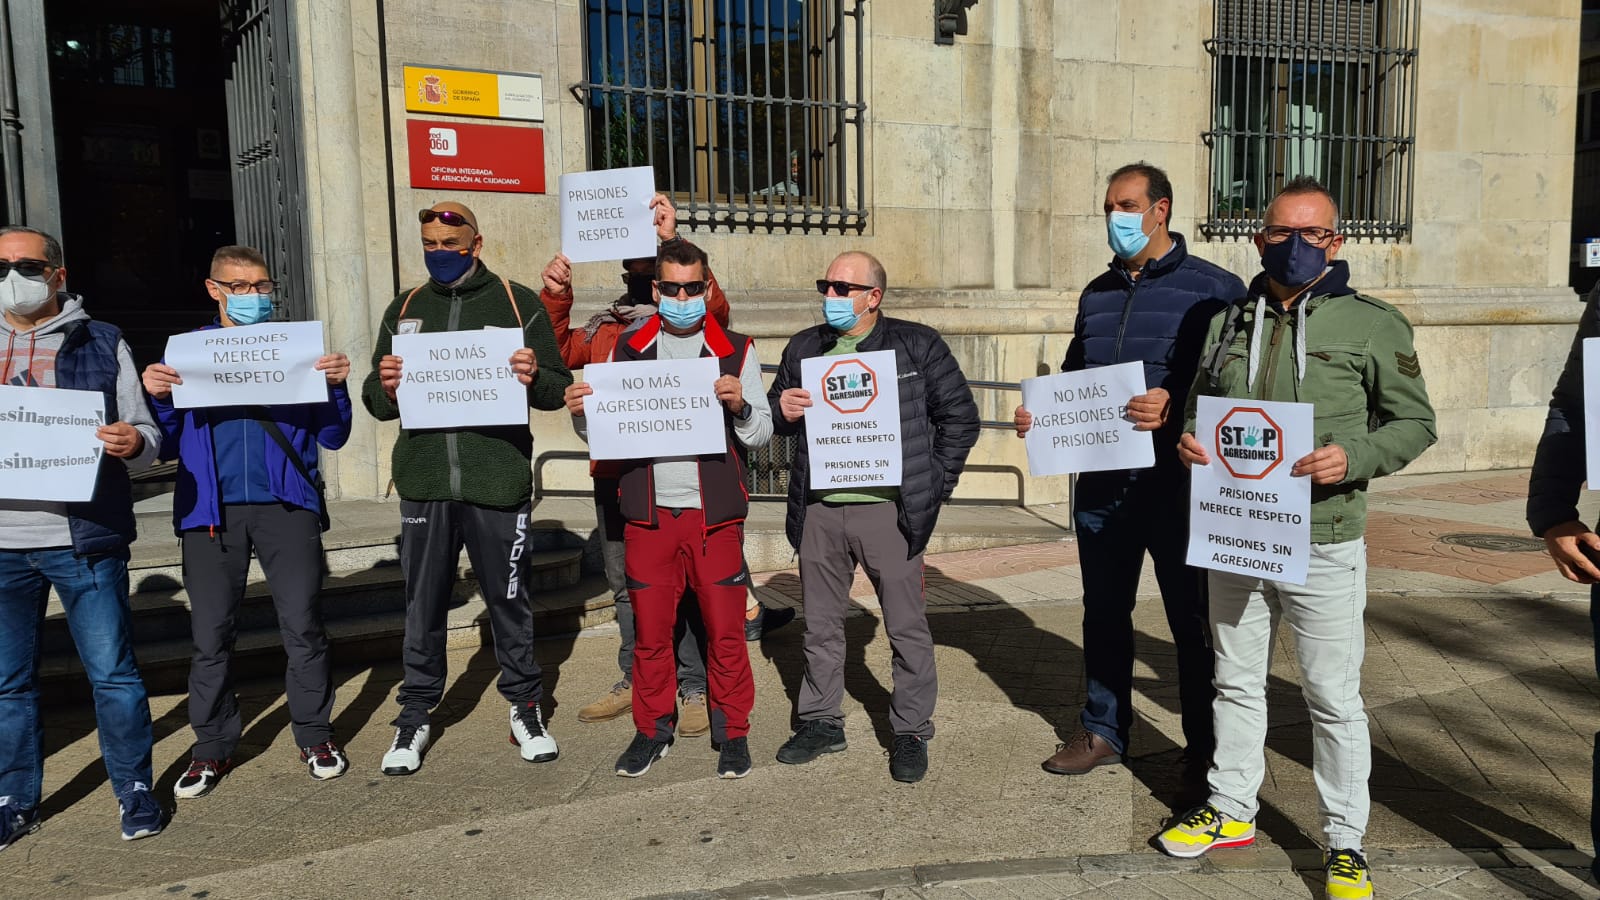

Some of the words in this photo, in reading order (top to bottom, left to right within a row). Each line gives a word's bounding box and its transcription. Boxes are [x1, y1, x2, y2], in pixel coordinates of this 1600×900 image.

[430, 139, 448, 150] 060
[441, 175, 473, 183] ATENCIÓN
[483, 177, 520, 185] CIUDADANO
[568, 187, 628, 203] PRISIONES
[577, 206, 625, 222] MERECE
[578, 226, 629, 242] RESPETO
[204, 333, 289, 346] PRISIONES
[213, 348, 281, 364] MERECE
[428, 348, 451, 361] NO
[455, 344, 486, 361] MÁS
[213, 370, 285, 384] RESPETO
[405, 367, 492, 384] AGRESIONES
[497, 366, 514, 379] EN
[621, 377, 645, 391] NO
[648, 372, 681, 389] MÁS
[826, 372, 872, 391] STP
[427, 388, 499, 404] PRISIONES
[829, 388, 873, 401] AGRESIONES
[1053, 389, 1075, 404] NO
[1077, 382, 1108, 400] MÁS
[596, 397, 687, 414] AGRESIONES
[691, 396, 710, 409] EN
[1032, 406, 1114, 428] AGRESIONES
[1118, 405, 1128, 420] E
[618, 418, 693, 435] PRISIONES
[831, 420, 878, 430] PRISIONES
[815, 435, 853, 446] MERECE
[856, 433, 896, 444] RESPETO
[1052, 429, 1119, 449] PRISIONES
[1221, 425, 1276, 447] STP
[1223, 447, 1276, 461] AGRESIONES
[824, 459, 870, 470] PRISIONES
[874, 459, 890, 468] SIN
[830, 473, 884, 484] AGRESIONES
[1219, 486, 1279, 503] PRISIONES
[1199, 501, 1242, 517] MERECE
[1248, 508, 1302, 525] RESPETO
[1208, 533, 1267, 552] PRISIONES
[1272, 543, 1292, 556] SIN
[506, 513, 528, 599] GIVOVA
[1211, 552, 1283, 573] AGRESIONES
